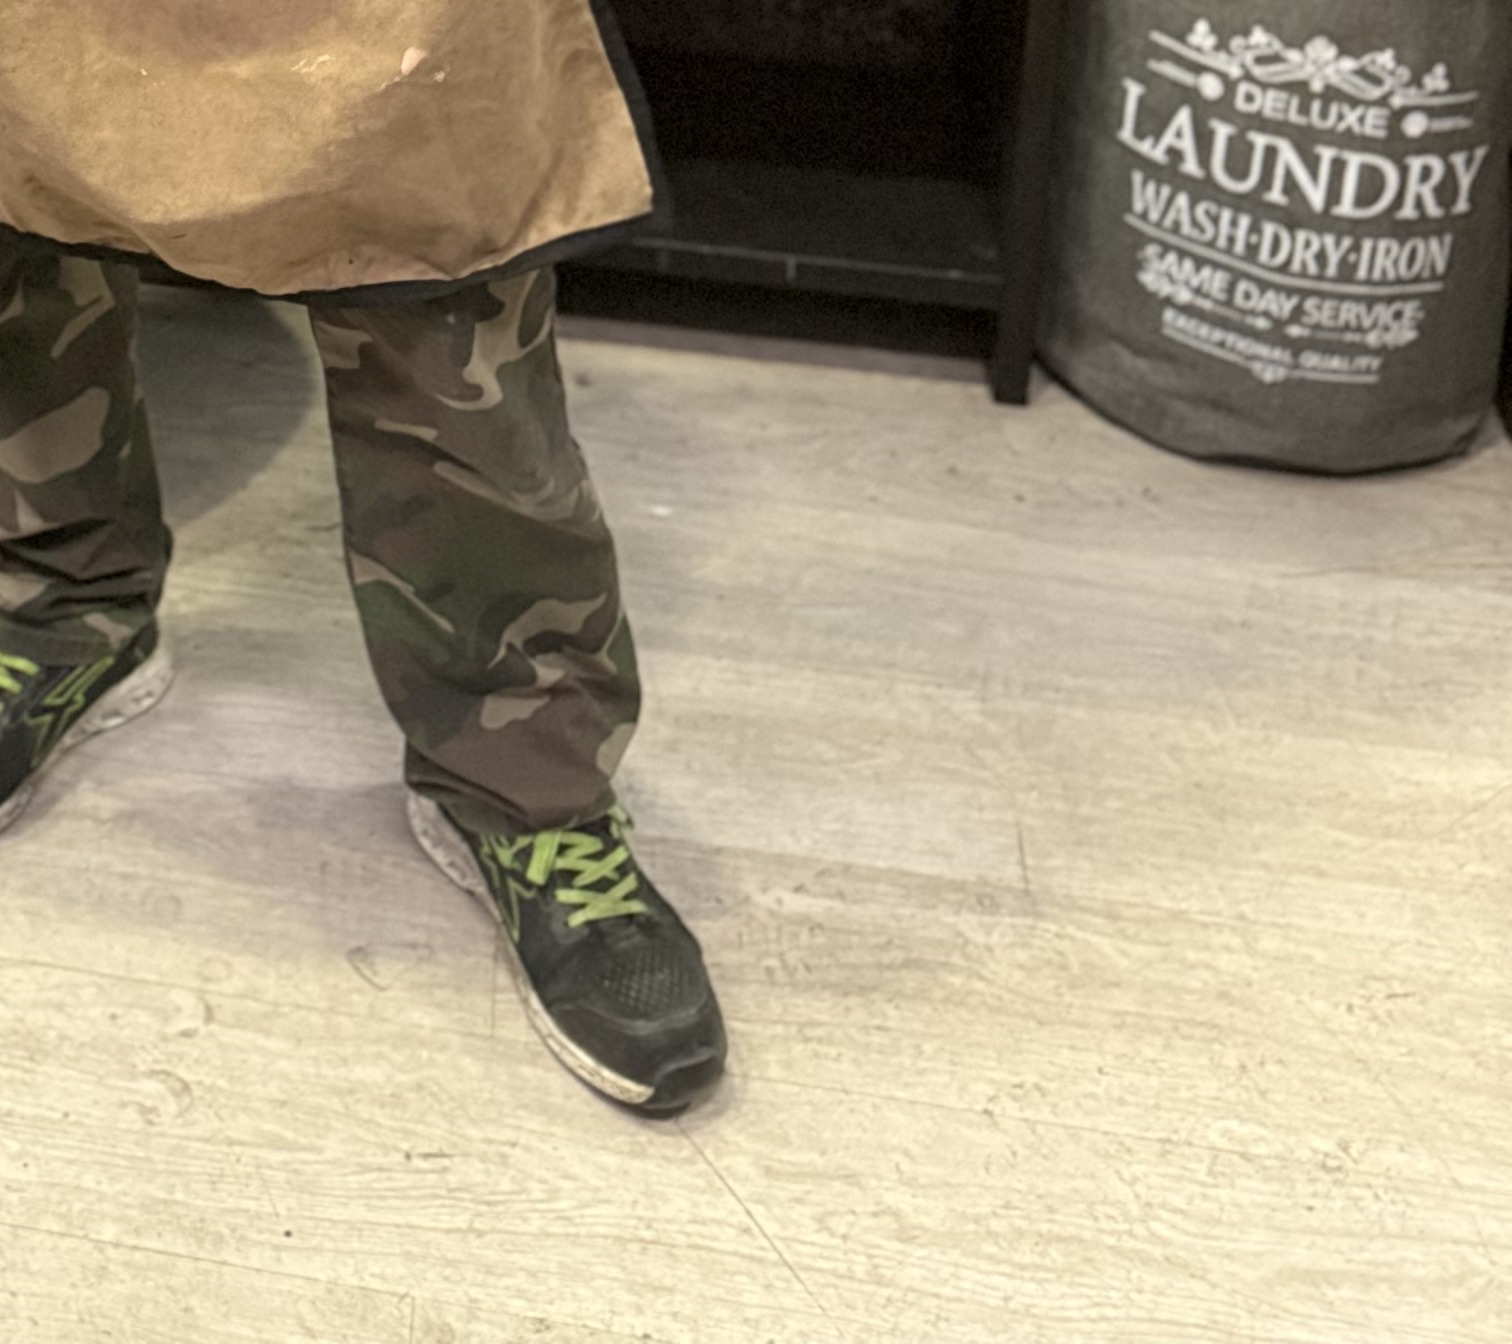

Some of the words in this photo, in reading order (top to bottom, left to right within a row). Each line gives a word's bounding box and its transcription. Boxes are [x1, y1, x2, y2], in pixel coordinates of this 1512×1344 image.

[1234, 80, 1389, 138] DELUXE
[1116, 77, 1489, 221] LAUNDRY
[1141, 243, 1233, 303] SAME
[1233, 278, 1300, 322] DAY
[1300, 295, 1422, 333] SERVICE
[1161, 306, 1293, 363] EXCEPTIONAL
[1298, 349, 1384, 373] QUALITY
